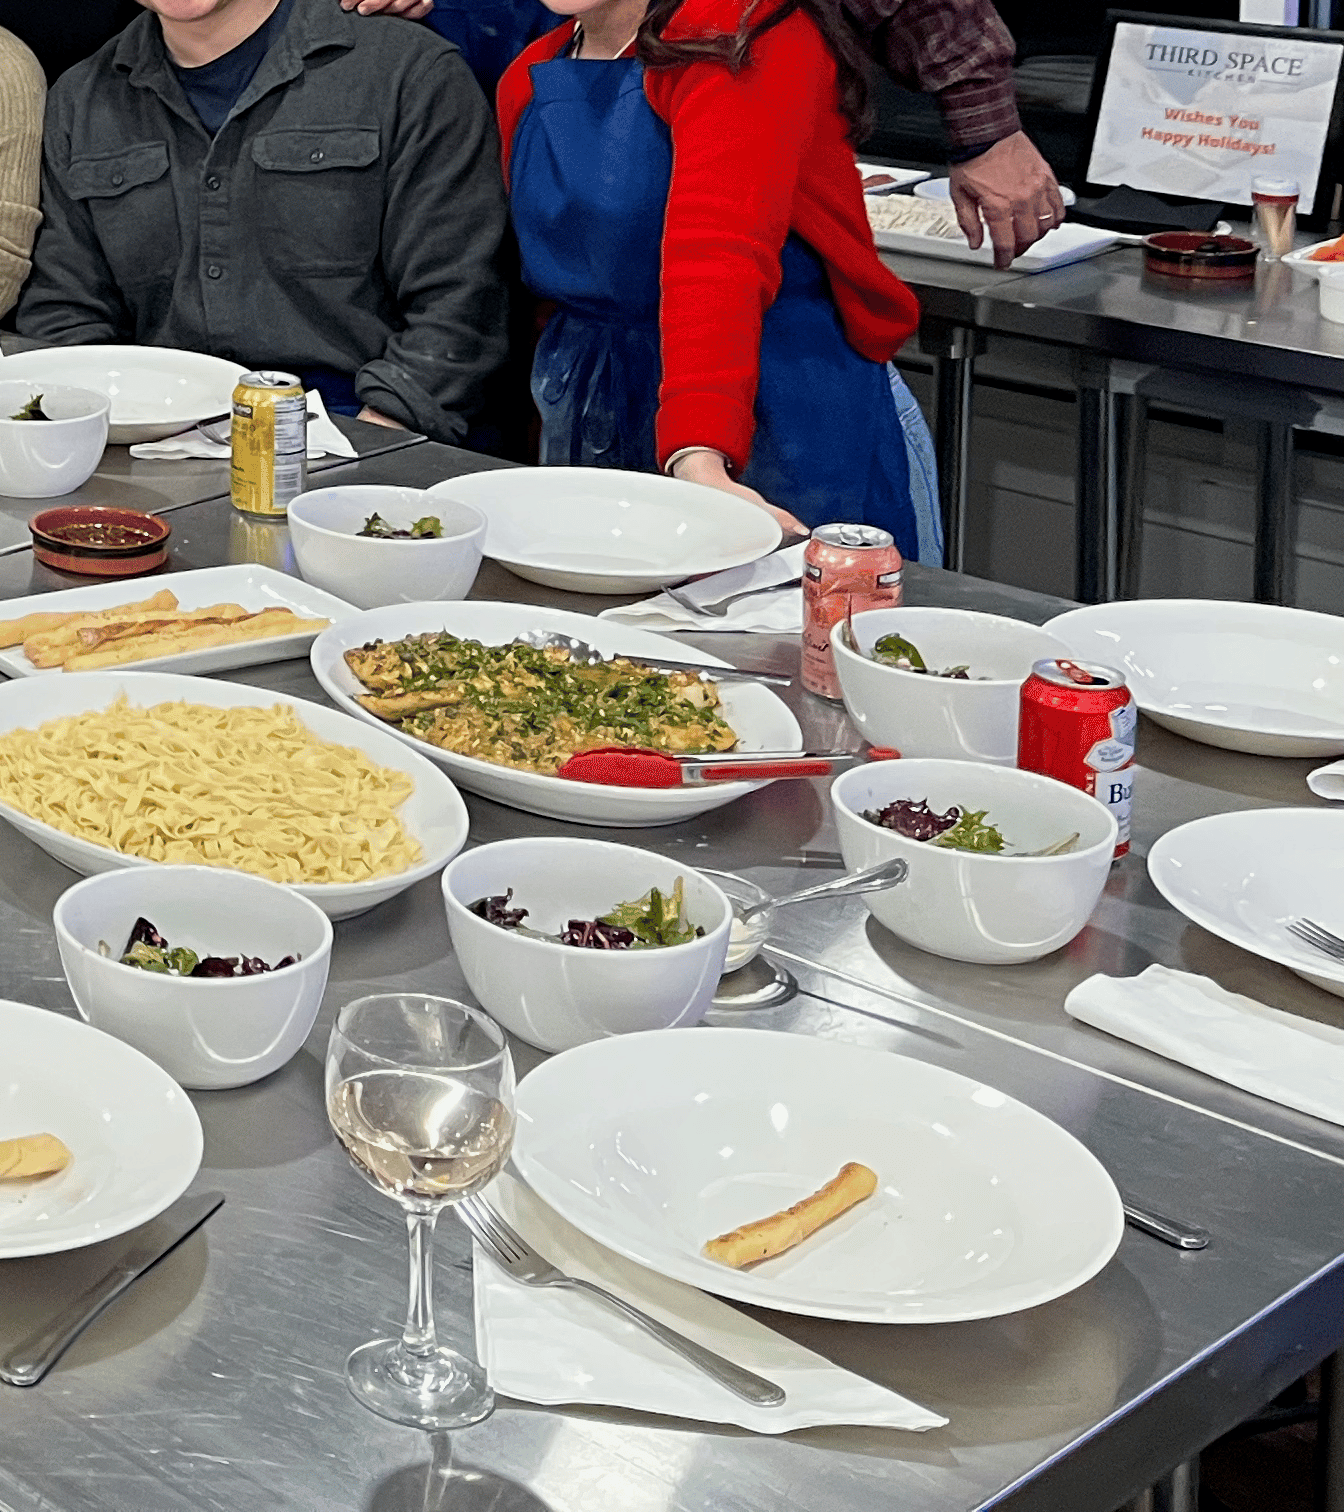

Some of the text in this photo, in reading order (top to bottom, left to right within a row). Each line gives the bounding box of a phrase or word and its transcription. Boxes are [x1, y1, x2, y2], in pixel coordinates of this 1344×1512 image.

[1145, 43, 1304, 76] THIRD SPACE
[1187, 68, 1256, 84] KITCHEN
[1164, 107, 1260, 130] Wishes You
[1141, 126, 1276, 156] Happy Holidays!
